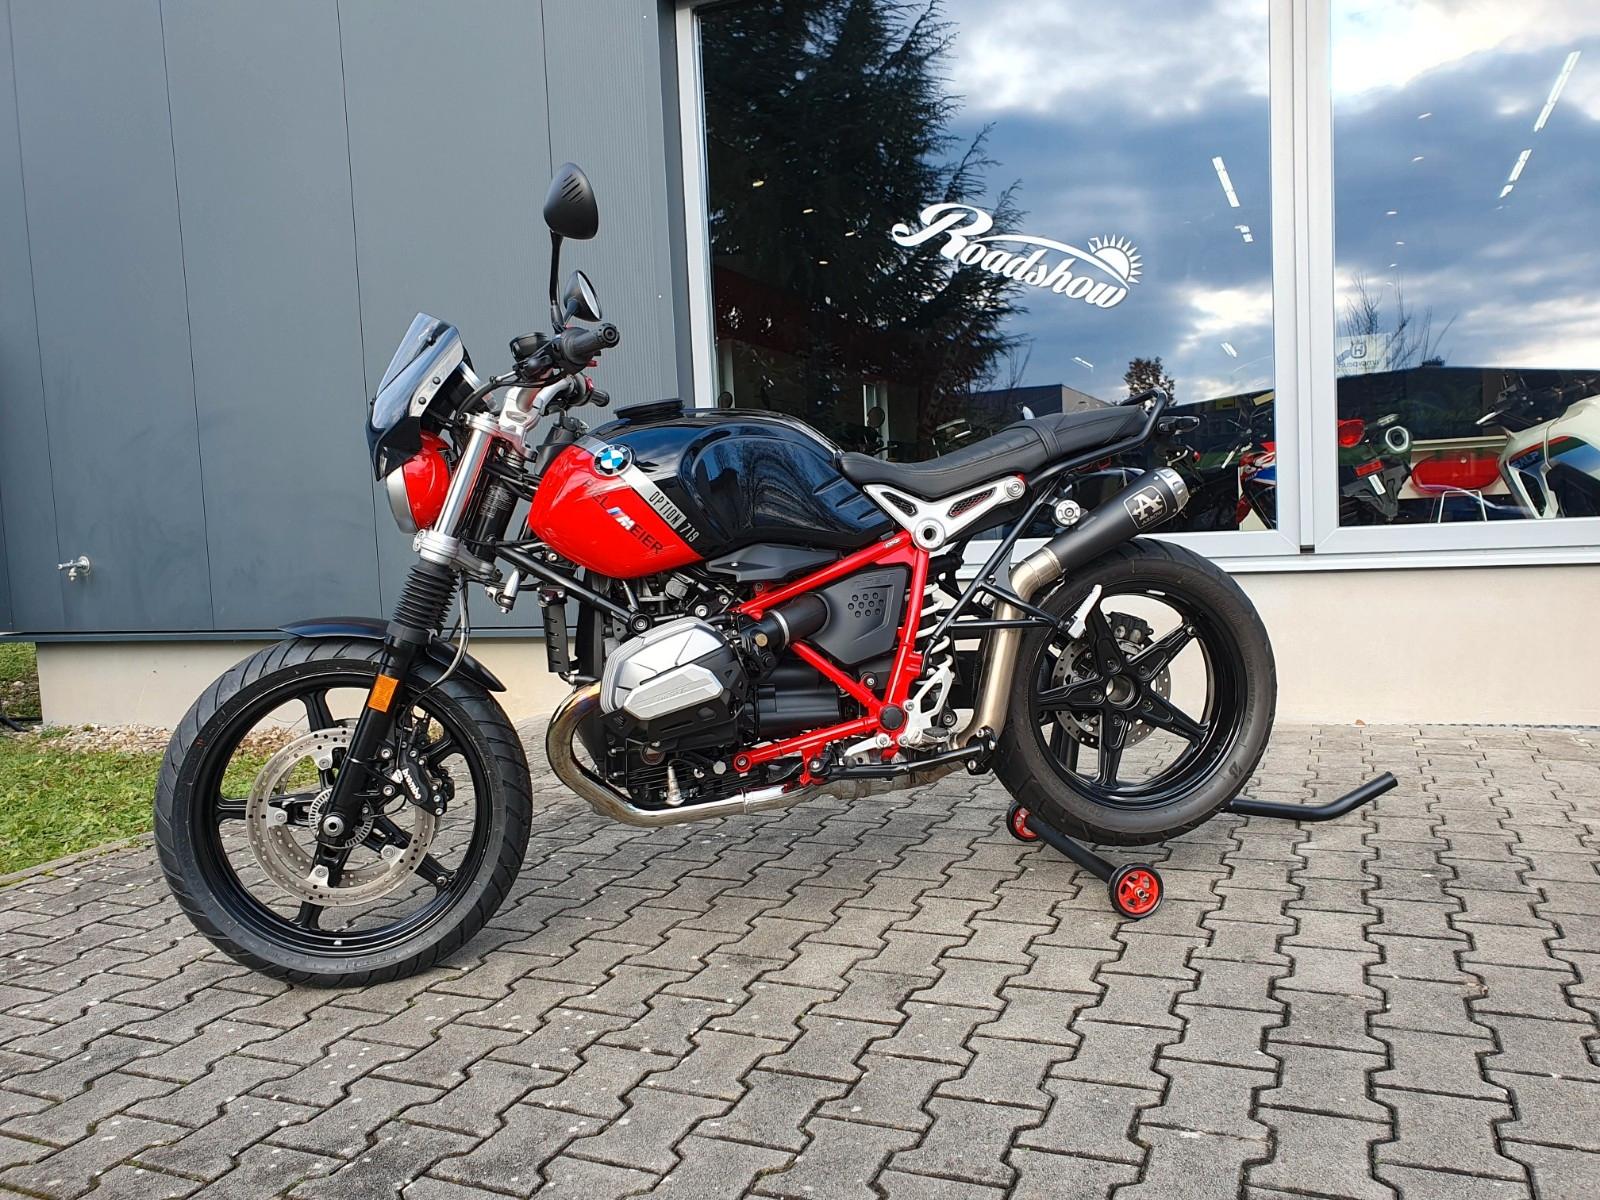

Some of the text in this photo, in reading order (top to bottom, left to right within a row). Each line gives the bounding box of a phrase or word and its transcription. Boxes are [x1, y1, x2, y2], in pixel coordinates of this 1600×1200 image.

[892, 203, 1127, 308] Roadshow
[649, 491, 700, 542] OPTION 719
[401, 767, 422, 800] brembo
